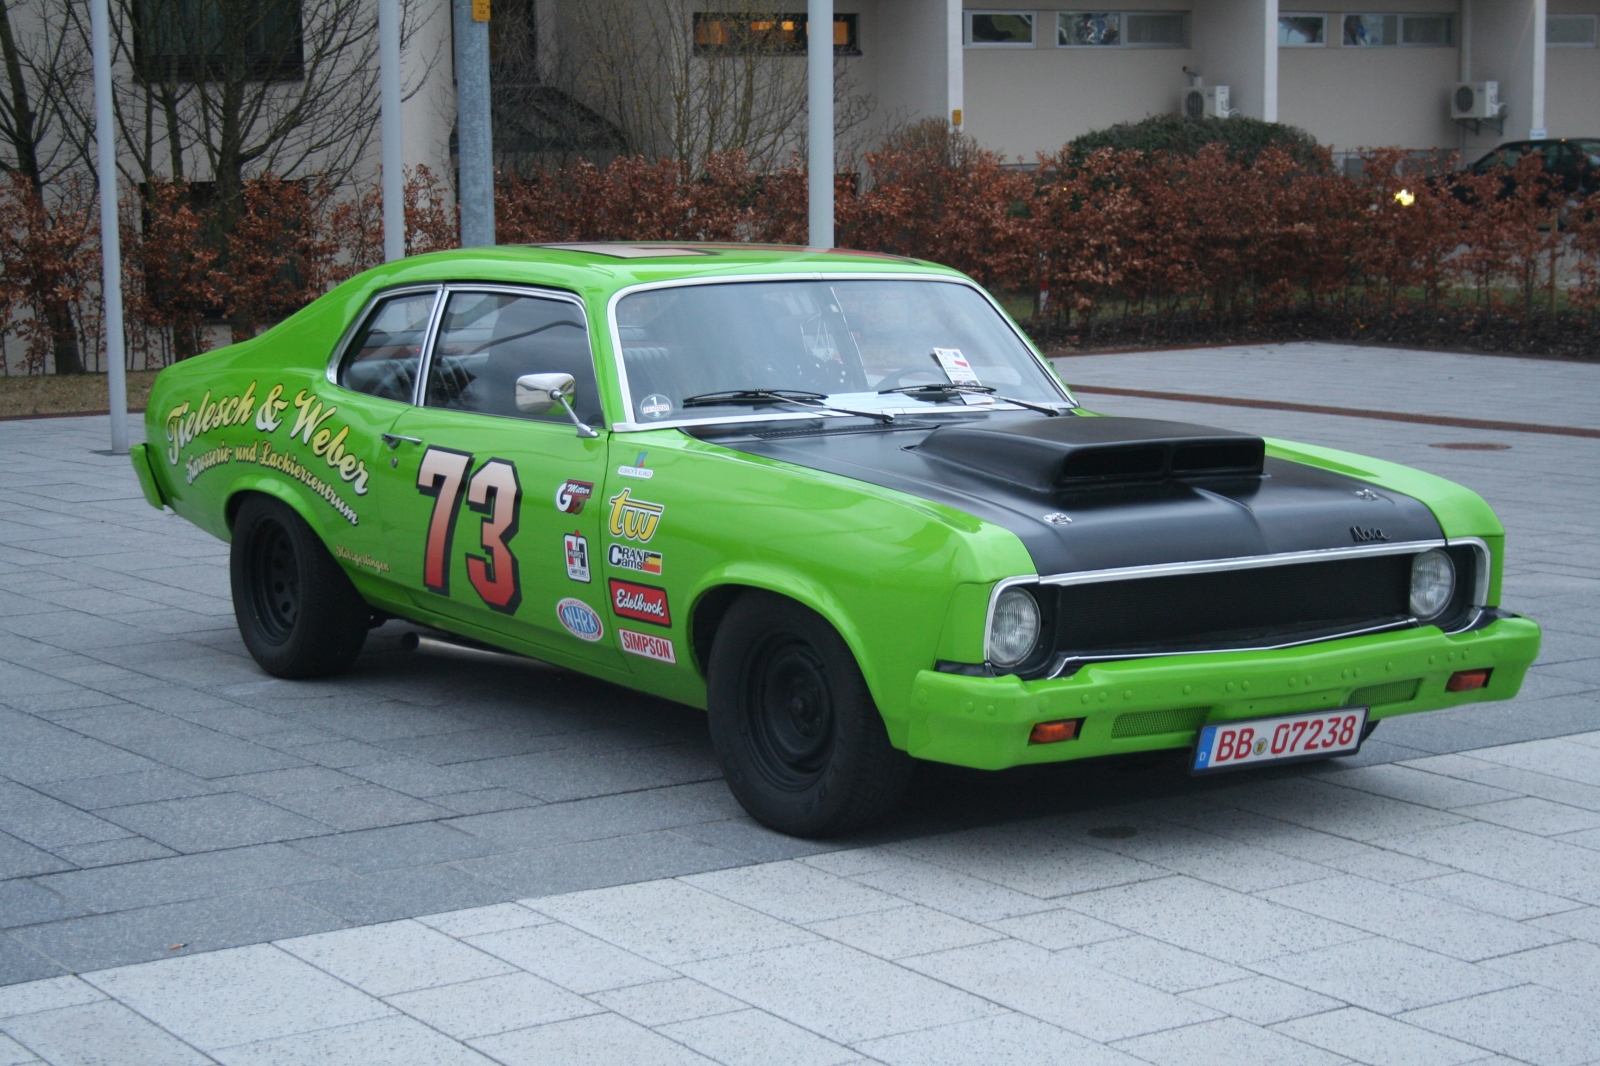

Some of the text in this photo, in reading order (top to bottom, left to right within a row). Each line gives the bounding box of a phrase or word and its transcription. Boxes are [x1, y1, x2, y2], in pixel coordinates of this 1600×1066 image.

[166, 380, 369, 495] Tielesch & Weber
[235, 438, 258, 462] und
[258, 439, 359, 527] Lackierzentrum
[567, 483, 590, 495] Mitter
[415, 444, 523, 617] 73
[1350, 526, 1392, 543] Nova
[568, 550, 584, 560] HURST
[616, 588, 665, 617] Edelbrock
[563, 606, 597, 633] NHRA
[622, 631, 671, 659] SIMPSON
[1215, 715, 1357, 762] BB 07238
[1199, 752, 1206, 761] D
